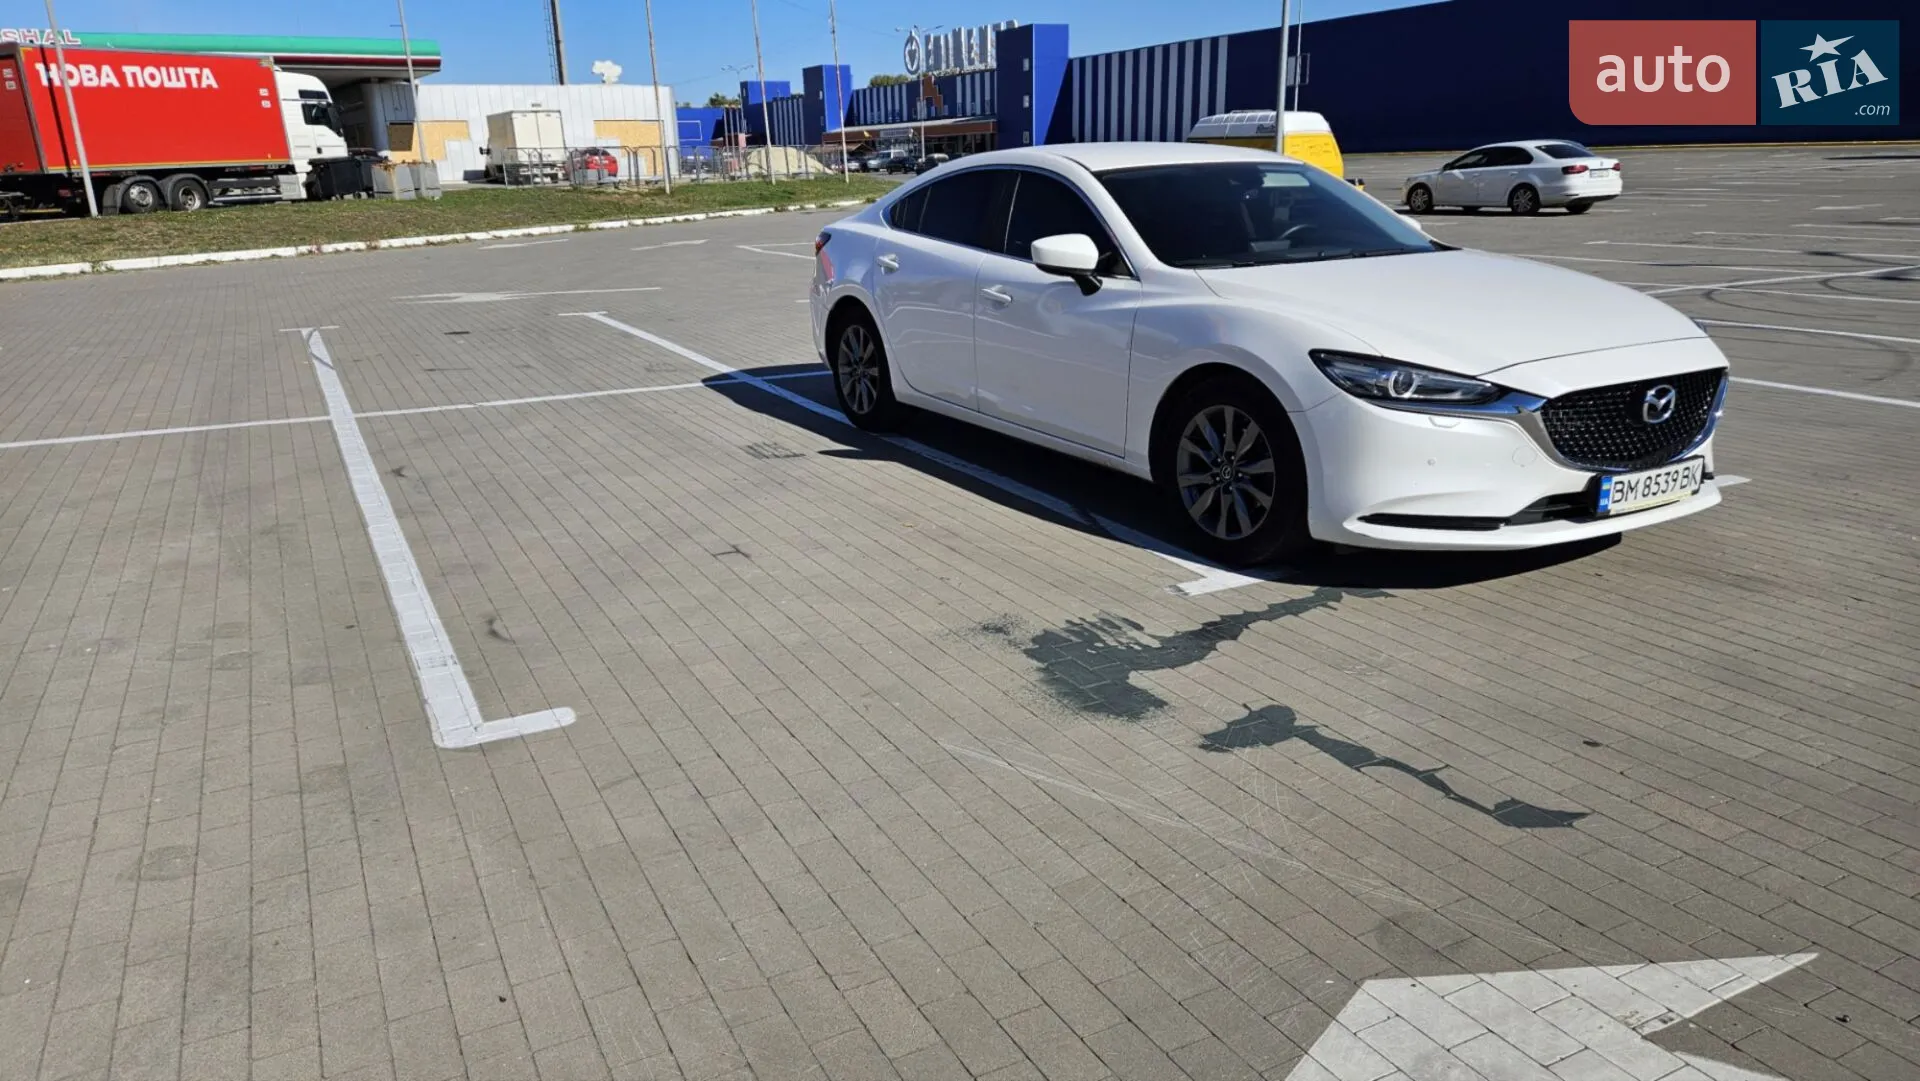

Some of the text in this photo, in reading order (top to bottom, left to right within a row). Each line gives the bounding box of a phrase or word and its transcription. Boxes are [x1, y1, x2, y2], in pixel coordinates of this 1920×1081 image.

[35, 63, 219, 88] НОВА ПОШТА
[1641, 470, 1679, 498] 8539
